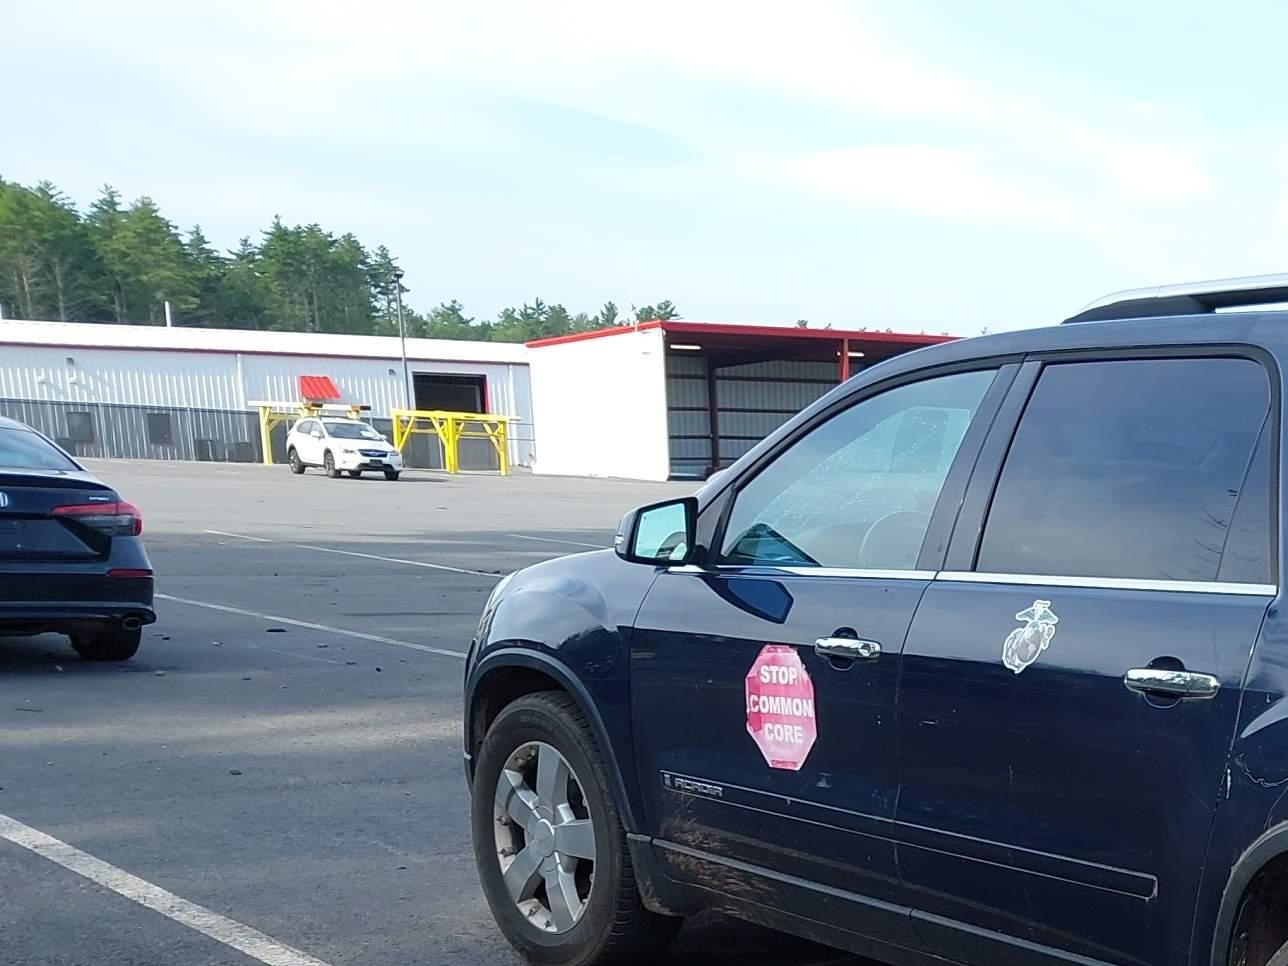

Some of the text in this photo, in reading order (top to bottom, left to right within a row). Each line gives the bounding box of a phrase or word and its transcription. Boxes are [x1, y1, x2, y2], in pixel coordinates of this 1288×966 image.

[760, 665, 797, 685] STOP
[749, 695, 813, 717] COMMON
[764, 723, 803, 743] CORE
